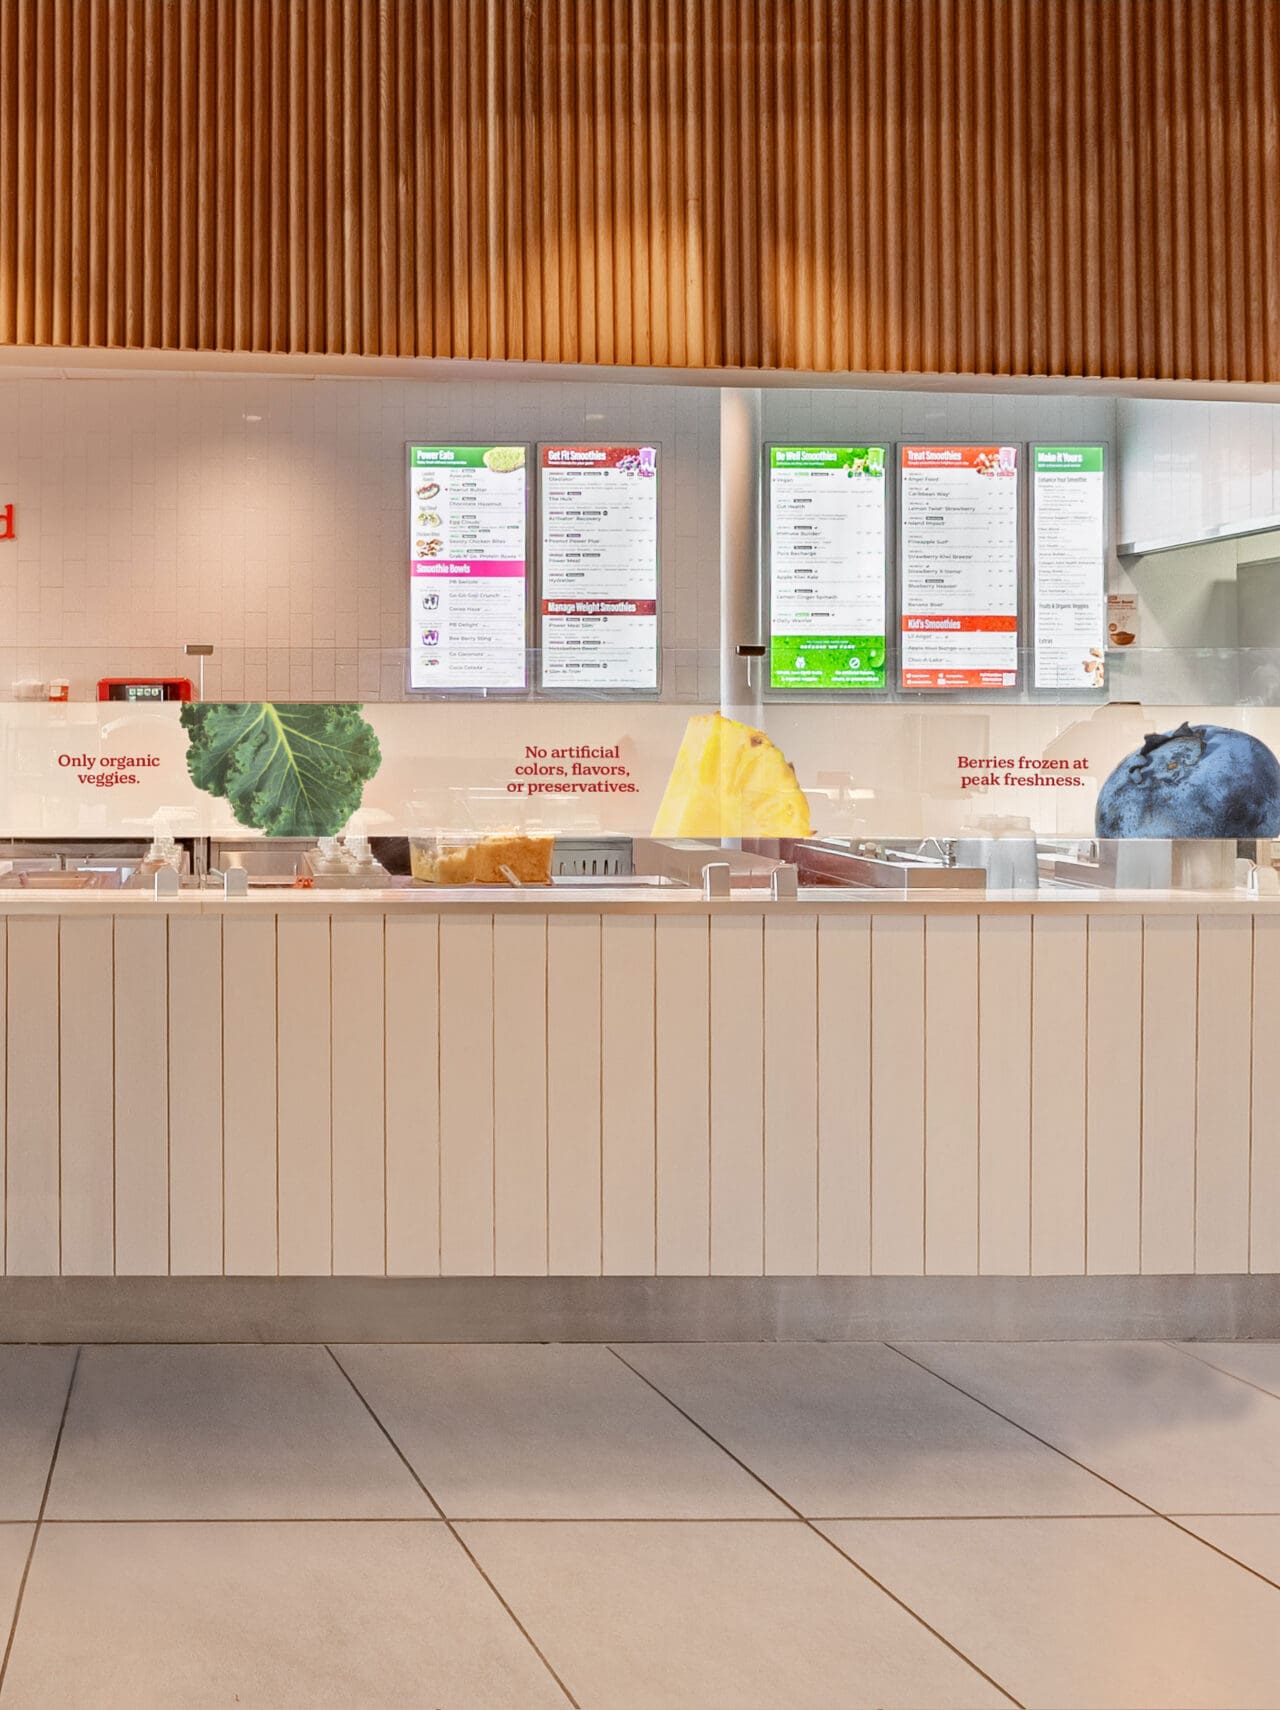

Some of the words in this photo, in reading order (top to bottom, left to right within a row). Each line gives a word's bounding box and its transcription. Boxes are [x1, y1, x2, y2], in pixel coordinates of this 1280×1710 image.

[417, 450, 438, 460] Power
[439, 450, 455, 460] Eats
[548, 450, 559, 460] Get
[560, 450, 570, 460] Fit
[570, 450, 606, 460] Smoothies
[776, 451, 785, 460] Be
[786, 451, 801, 460] Well
[801, 451, 838, 460] Smoothies
[908, 450, 925, 460] Treat
[925, 450, 962, 460] Smoothies
[1038, 453, 1056, 462] Make
[1063, 453, 1083, 462] Yours
[416, 564, 449, 574] Smoothie
[449, 564, 471, 574] Bowls
[548, 602, 575, 612] Manage
[576, 602, 600, 612] Weight
[600, 602, 637, 612] Smoothies
[908, 619, 924, 629] Kid's
[925, 619, 961, 629] Smoothies
[525, 746, 548, 758] No
[551, 744, 621, 759] artificial
[58, 754, 96, 771] Only
[100, 754, 161, 770] organic
[957, 756, 1015, 769] Berries
[1019, 756, 1069, 770] frozen
[1073, 758, 1089, 769] at
[515, 762, 568, 778] colors,
[572, 762, 631, 778] flavors,
[78, 771, 141, 787] veggies.
[961, 773, 1000, 788] peak
[1004, 773, 1085, 787] freshness.
[507, 783, 524, 793] or
[528, 780, 640, 796] preservatives.
